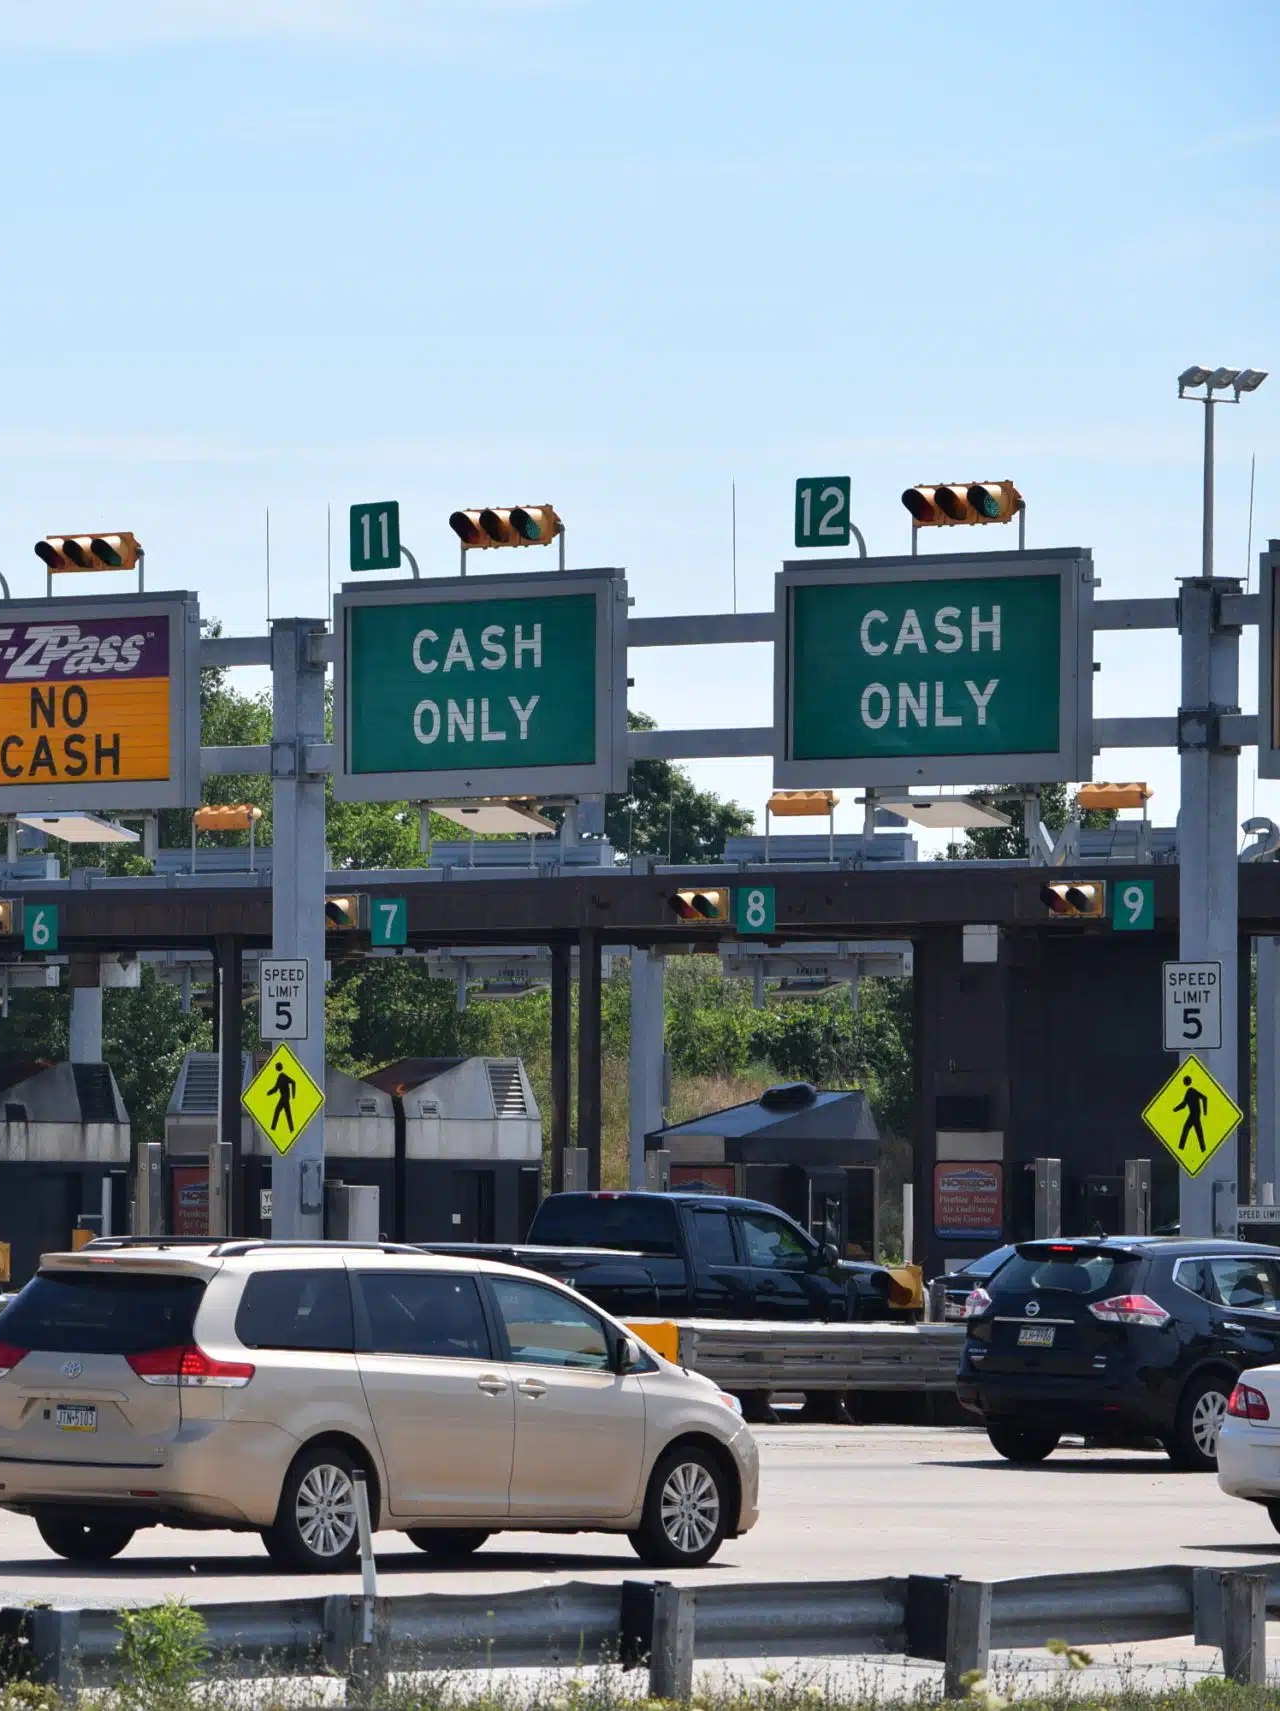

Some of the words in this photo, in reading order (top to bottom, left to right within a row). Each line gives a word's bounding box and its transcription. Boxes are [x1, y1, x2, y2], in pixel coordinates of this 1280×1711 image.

[801, 487, 844, 535] 12
[361, 512, 388, 559] 11
[861, 606, 1000, 655] CASH
[413, 624, 541, 673] CASH
[31, 685, 87, 728] NO
[414, 696, 539, 744] ONLY
[861, 680, 999, 728] ONLY
[1, 734, 119, 777] CASH
[380, 905, 397, 938] 7
[747, 891, 765, 926] 8
[1124, 887, 1143, 922] 9
[33, 912, 49, 944] 6
[264, 969, 304, 981] SPEED
[269, 985, 299, 998] LIMIT
[1169, 973, 1216, 986] SPEED
[1174, 991, 1210, 1004] LIMIT
[276, 1002, 292, 1030] 5
[1183, 1008, 1202, 1039] 5
[1238, 1210, 1261, 1219] SPEED
